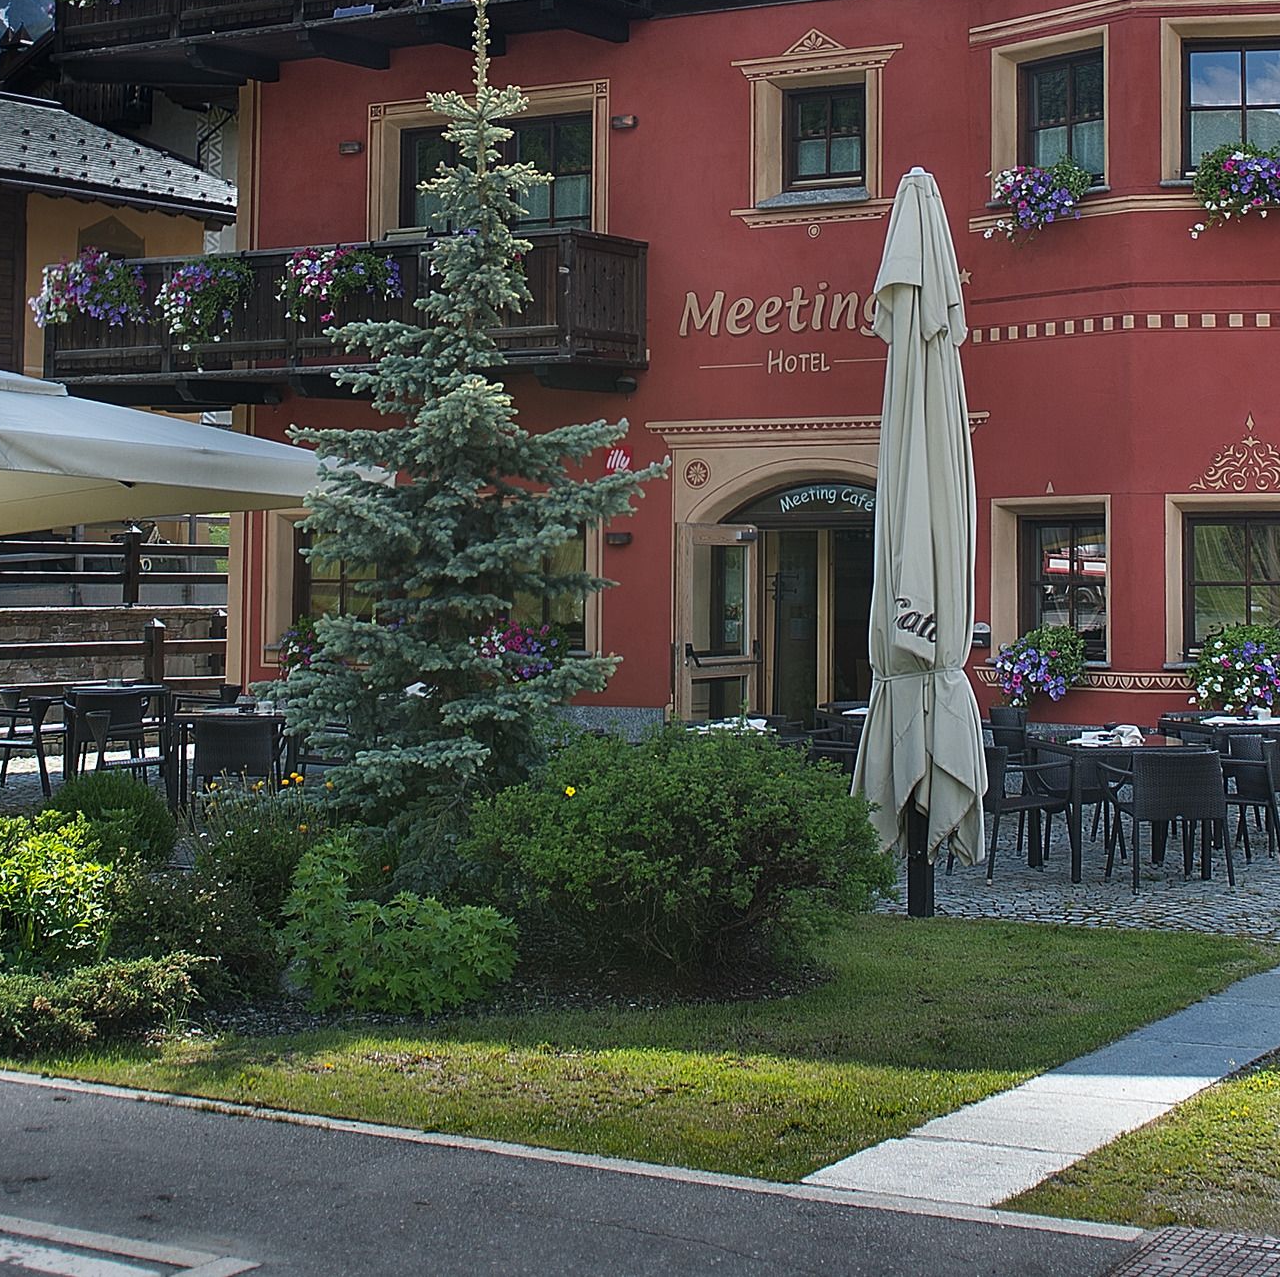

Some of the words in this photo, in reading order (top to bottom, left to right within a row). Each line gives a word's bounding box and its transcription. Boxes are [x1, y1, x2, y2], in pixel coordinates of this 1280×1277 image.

[678, 282, 879, 338] Meeting
[767, 349, 831, 374] HOTEL
[606, 449, 630, 470] illy
[780, 486, 837, 513] Meeting
[841, 488, 874, 512] Café
